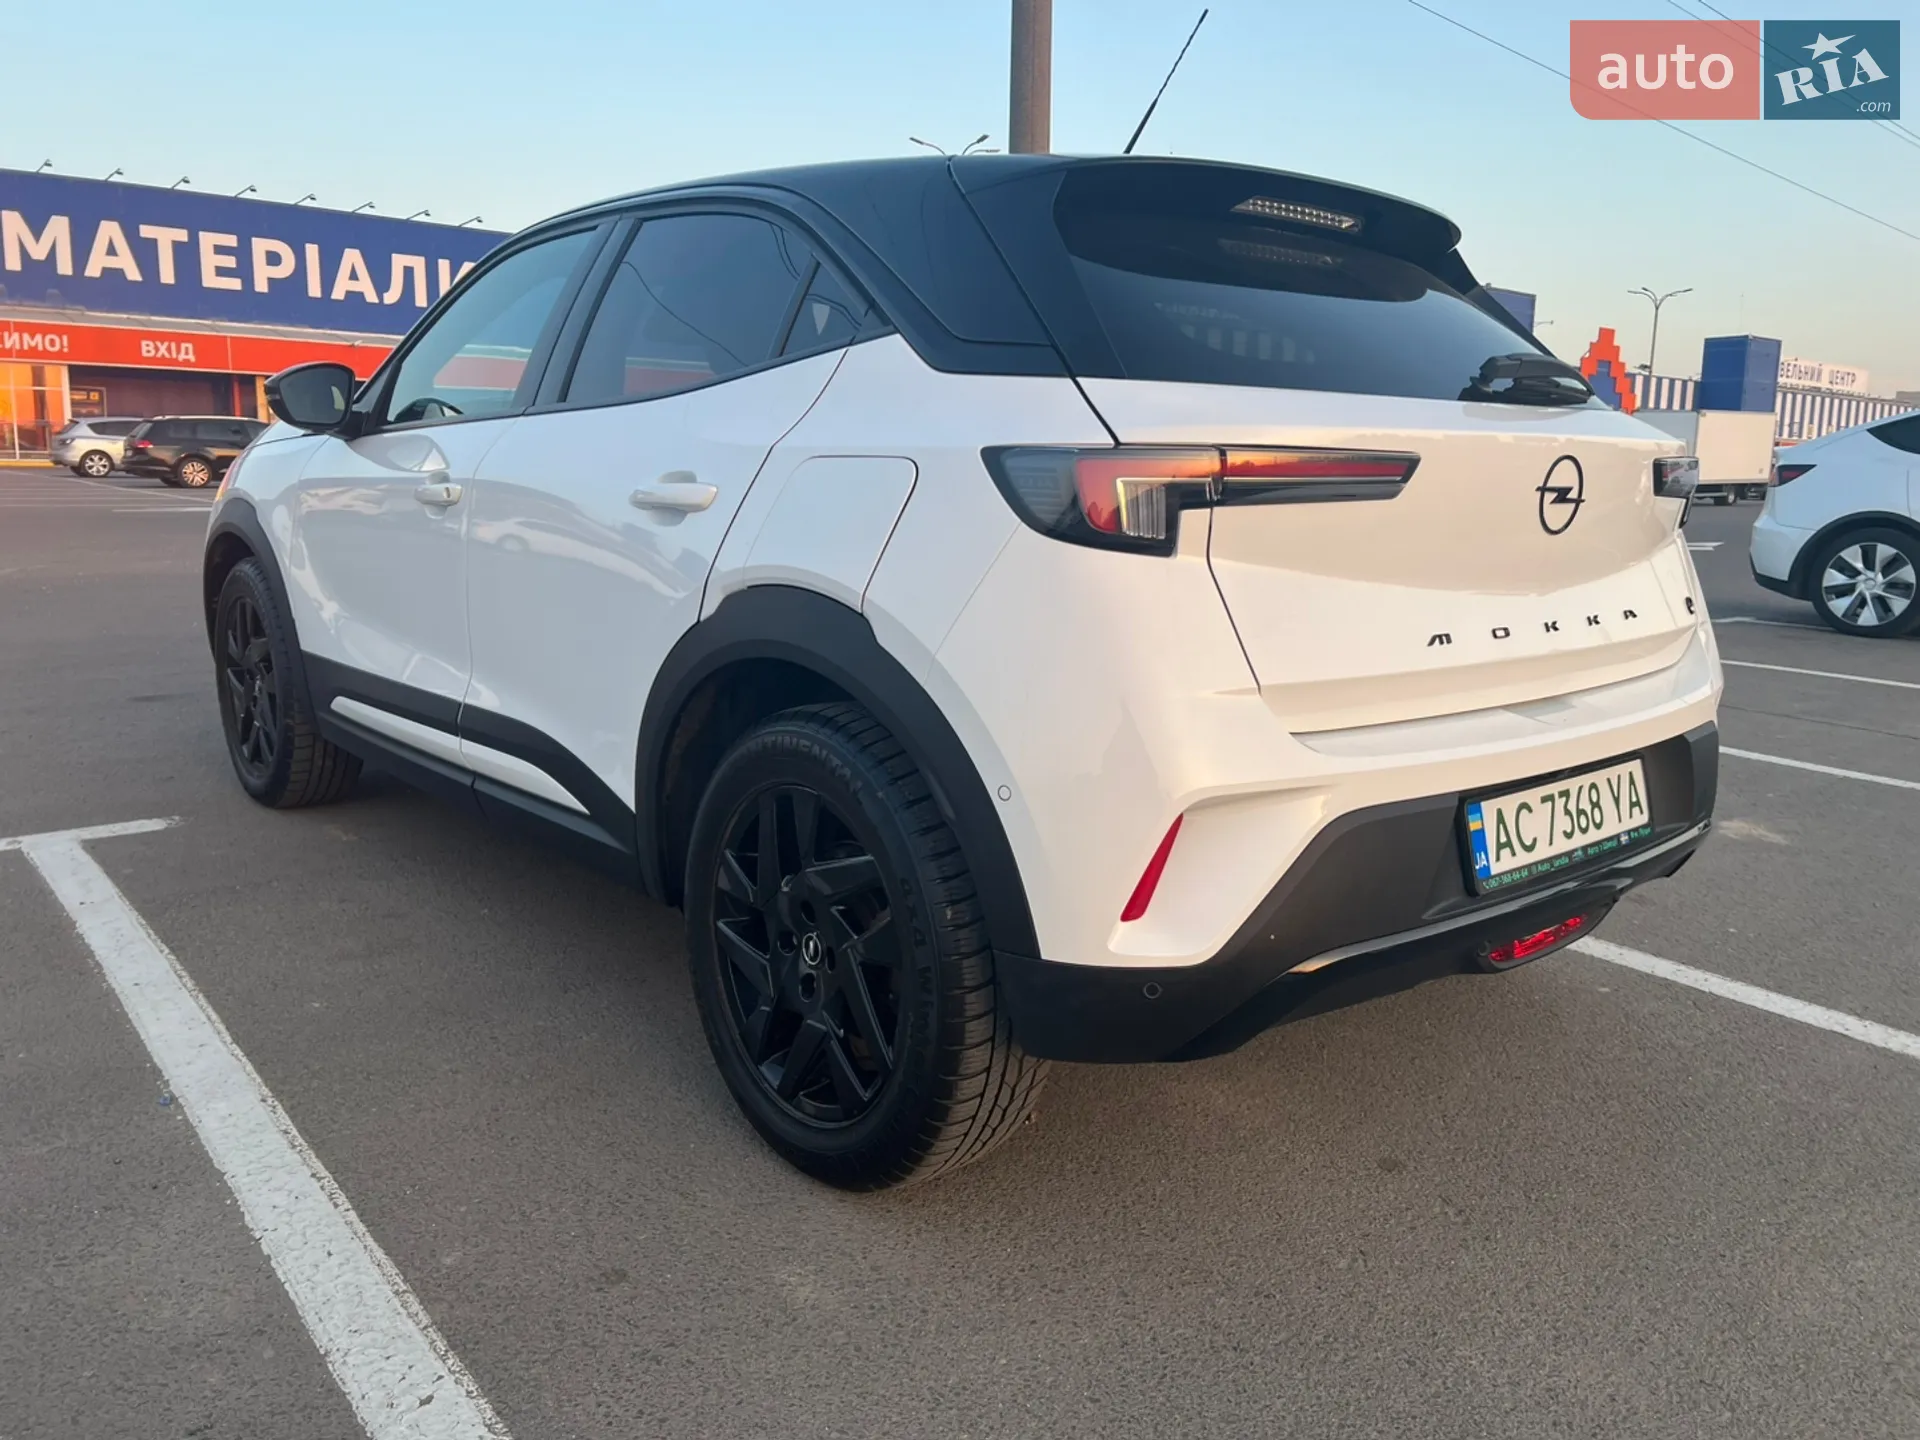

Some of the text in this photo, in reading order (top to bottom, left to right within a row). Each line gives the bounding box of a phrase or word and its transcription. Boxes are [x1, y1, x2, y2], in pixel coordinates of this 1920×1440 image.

[0, 331, 69, 353] ИМО!
[140, 339, 196, 362] ВХІД
[1828, 369, 1857, 388] ЦЕНТР
[1427, 608, 1638, 647] MOKKA
[1495, 771, 1644, 862] AC 7368 YA
